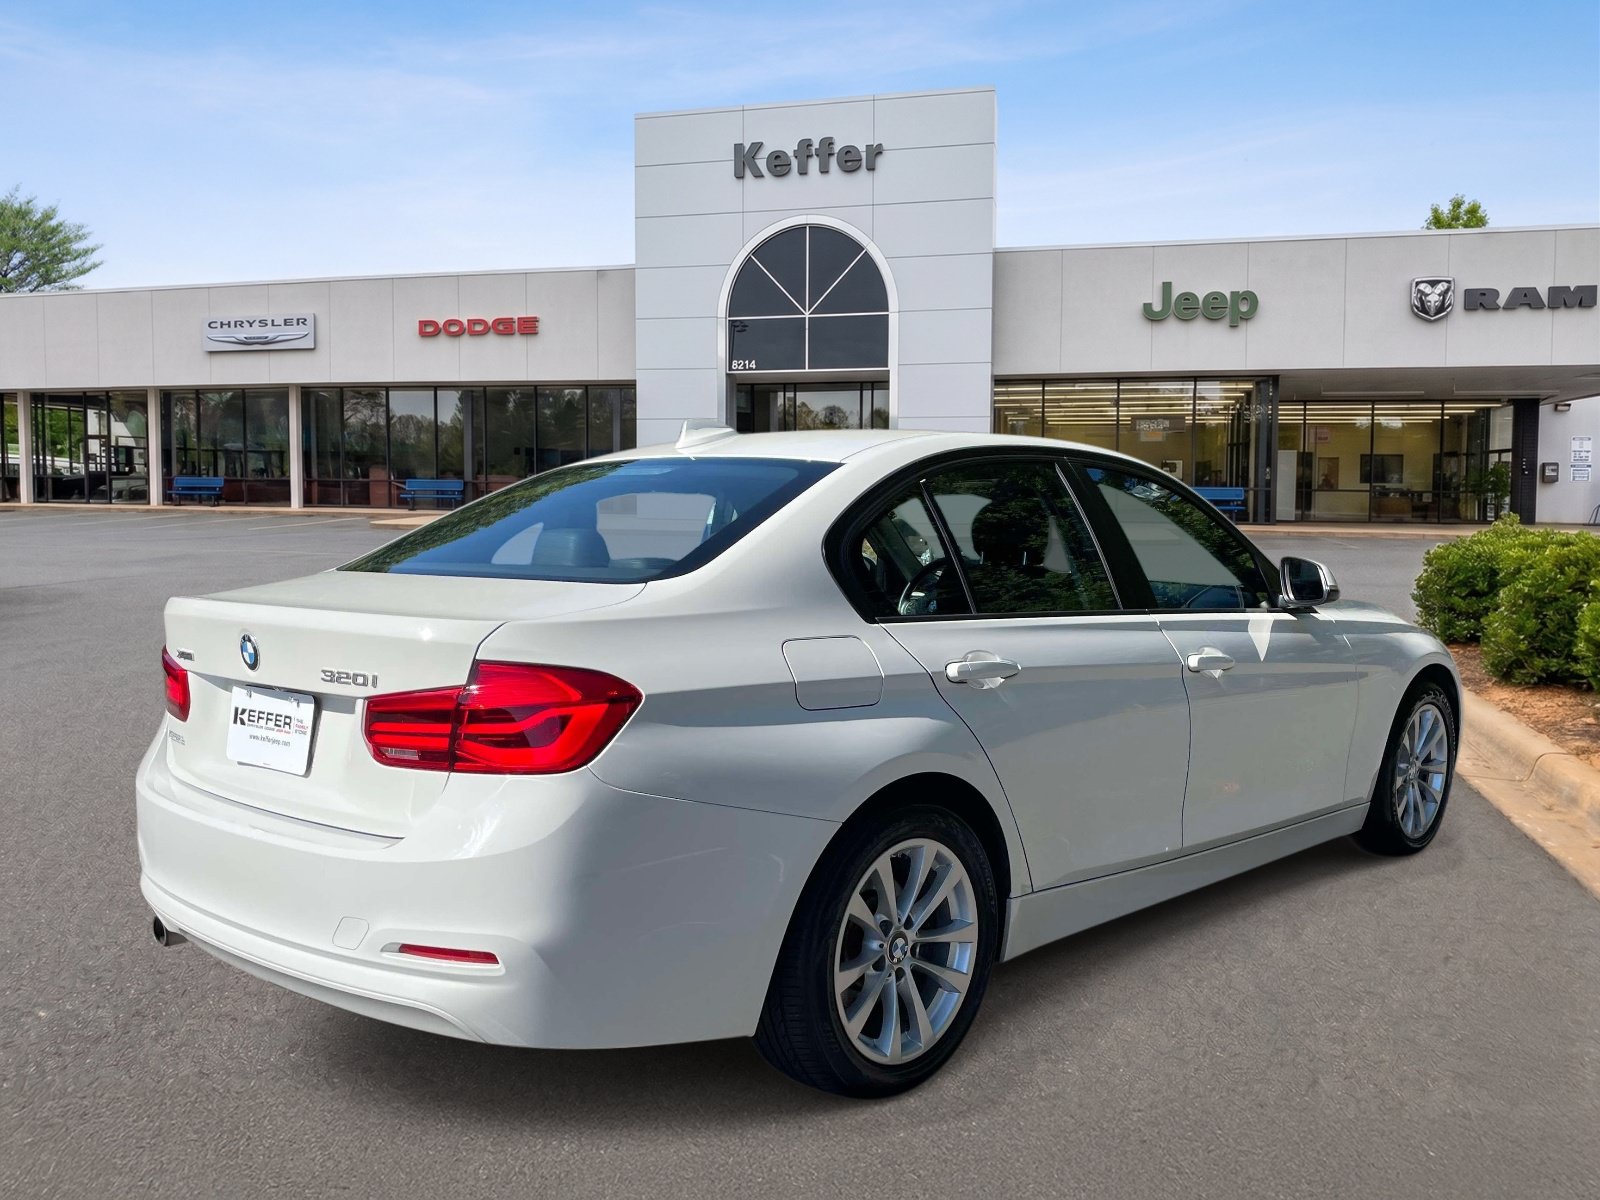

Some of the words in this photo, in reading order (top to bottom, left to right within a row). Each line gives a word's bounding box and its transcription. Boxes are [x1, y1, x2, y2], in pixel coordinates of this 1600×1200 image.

[733, 137, 884, 179] Keffer
[1143, 281, 1260, 327] Jeep
[1464, 284, 1598, 311] RAM
[207, 317, 308, 329] CHRYSLER
[418, 316, 540, 337] DODGE
[731, 360, 757, 370] 8214
[233, 706, 292, 730] KEFFER
